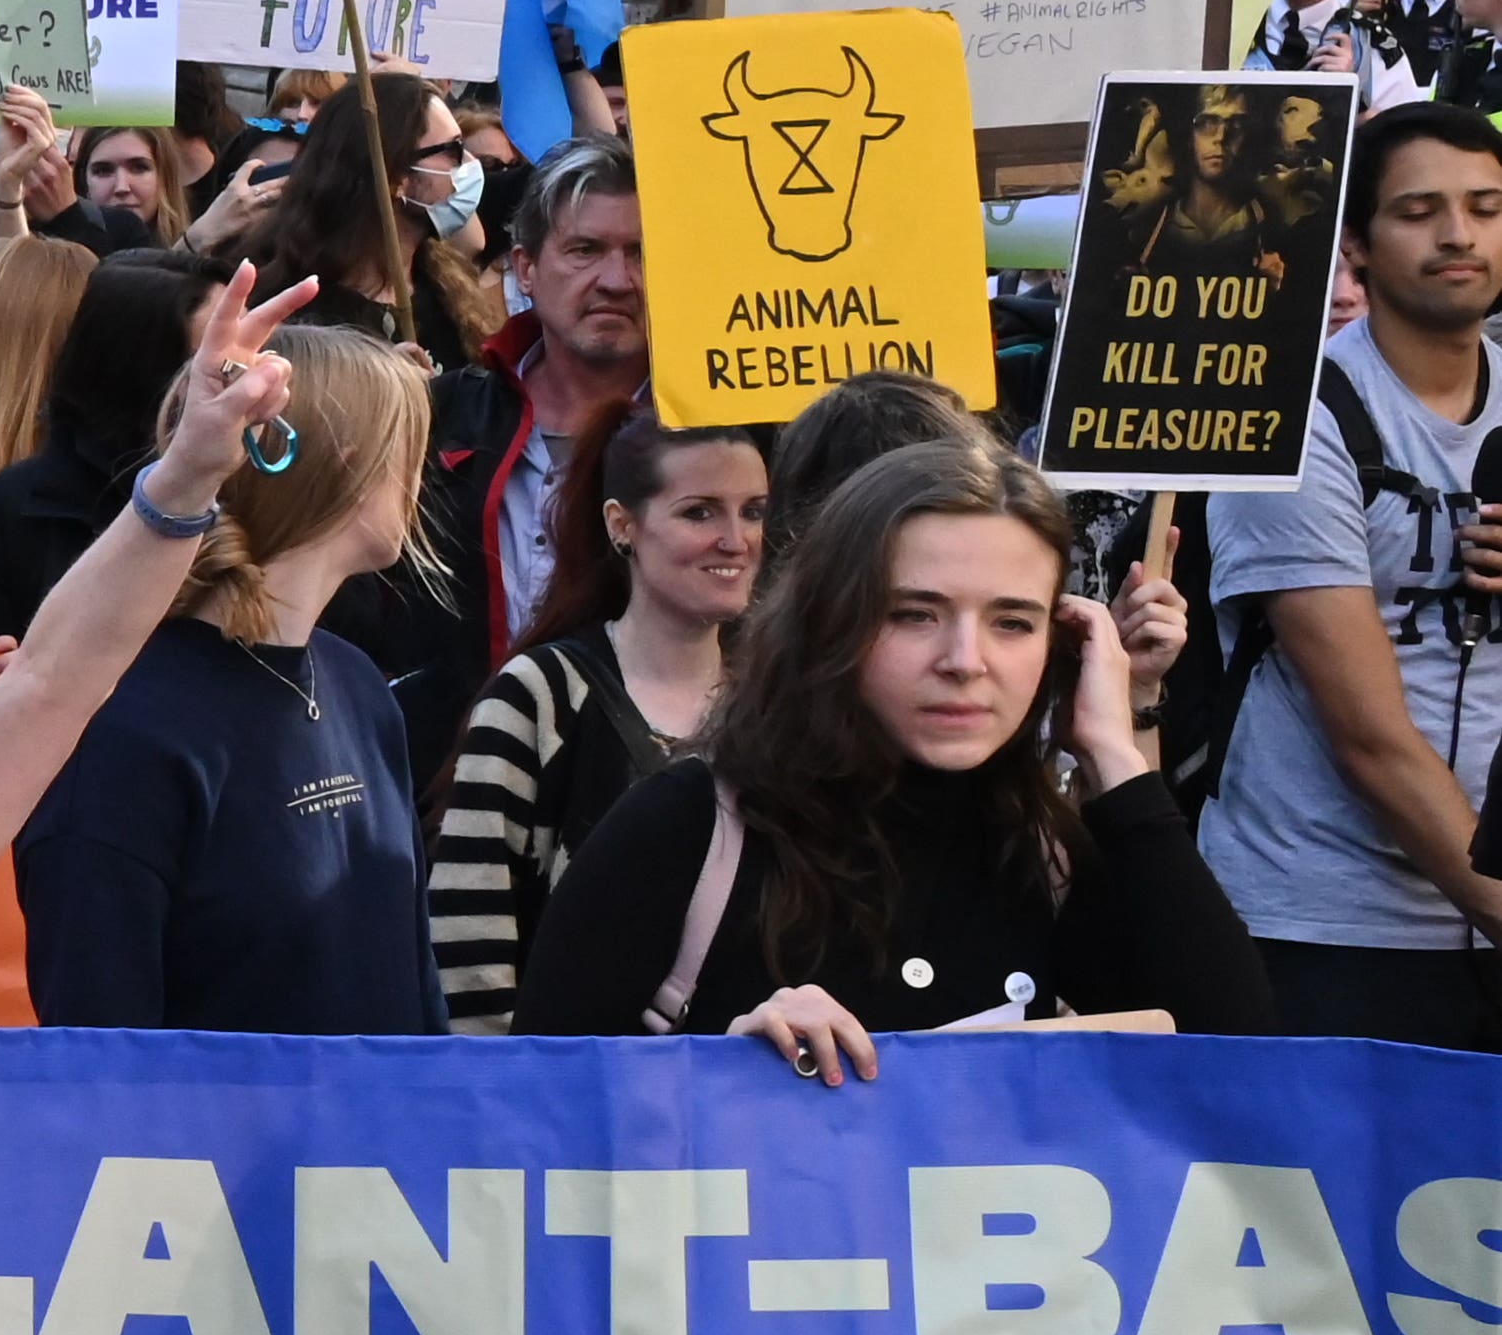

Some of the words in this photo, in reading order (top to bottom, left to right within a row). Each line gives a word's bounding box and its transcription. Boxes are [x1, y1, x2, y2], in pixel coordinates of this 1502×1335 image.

[11, 65, 48, 89] Cows
[724, 285, 900, 333] ANIMAL
[1125, 275, 1178, 320] DO
[1196, 275, 1267, 320] YOU
[1102, 341, 1179, 386] KILL
[1194, 342, 1267, 386] FOR
[1067, 406, 1282, 454] PLEASURE?
[302, 782, 317, 793] AM
[308, 802, 321, 813] AM
